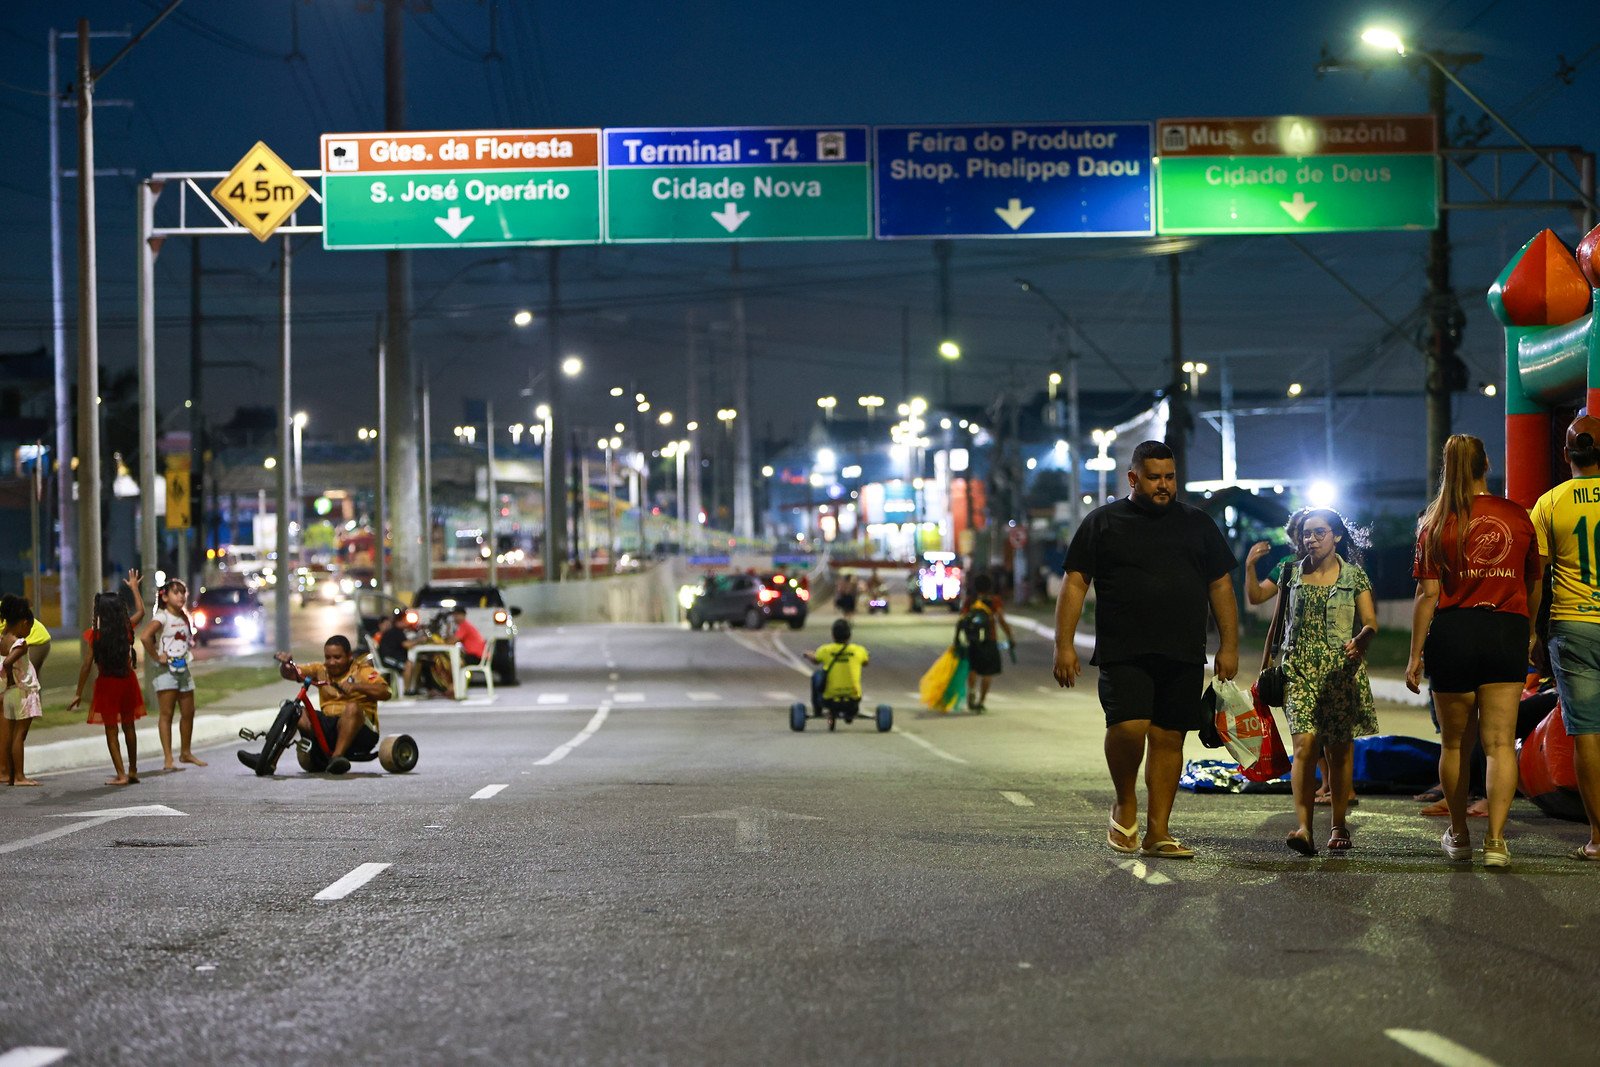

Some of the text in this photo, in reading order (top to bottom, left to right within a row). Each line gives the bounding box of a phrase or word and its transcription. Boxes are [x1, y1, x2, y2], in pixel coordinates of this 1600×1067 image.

[622, 138, 741, 162] Terminal
[765, 137, 800, 160] T4
[907, 128, 1118, 153] Feira do Produtor
[1189, 127, 1245, 147] Mus.
[369, 137, 574, 163] Gtes. da Floresta
[890, 155, 1140, 181] Shop. Phelippe Daou
[1205, 163, 1392, 186] Cidade de Deus
[370, 177, 571, 204] S. José Operário
[651, 175, 821, 200] Cidade Nova
